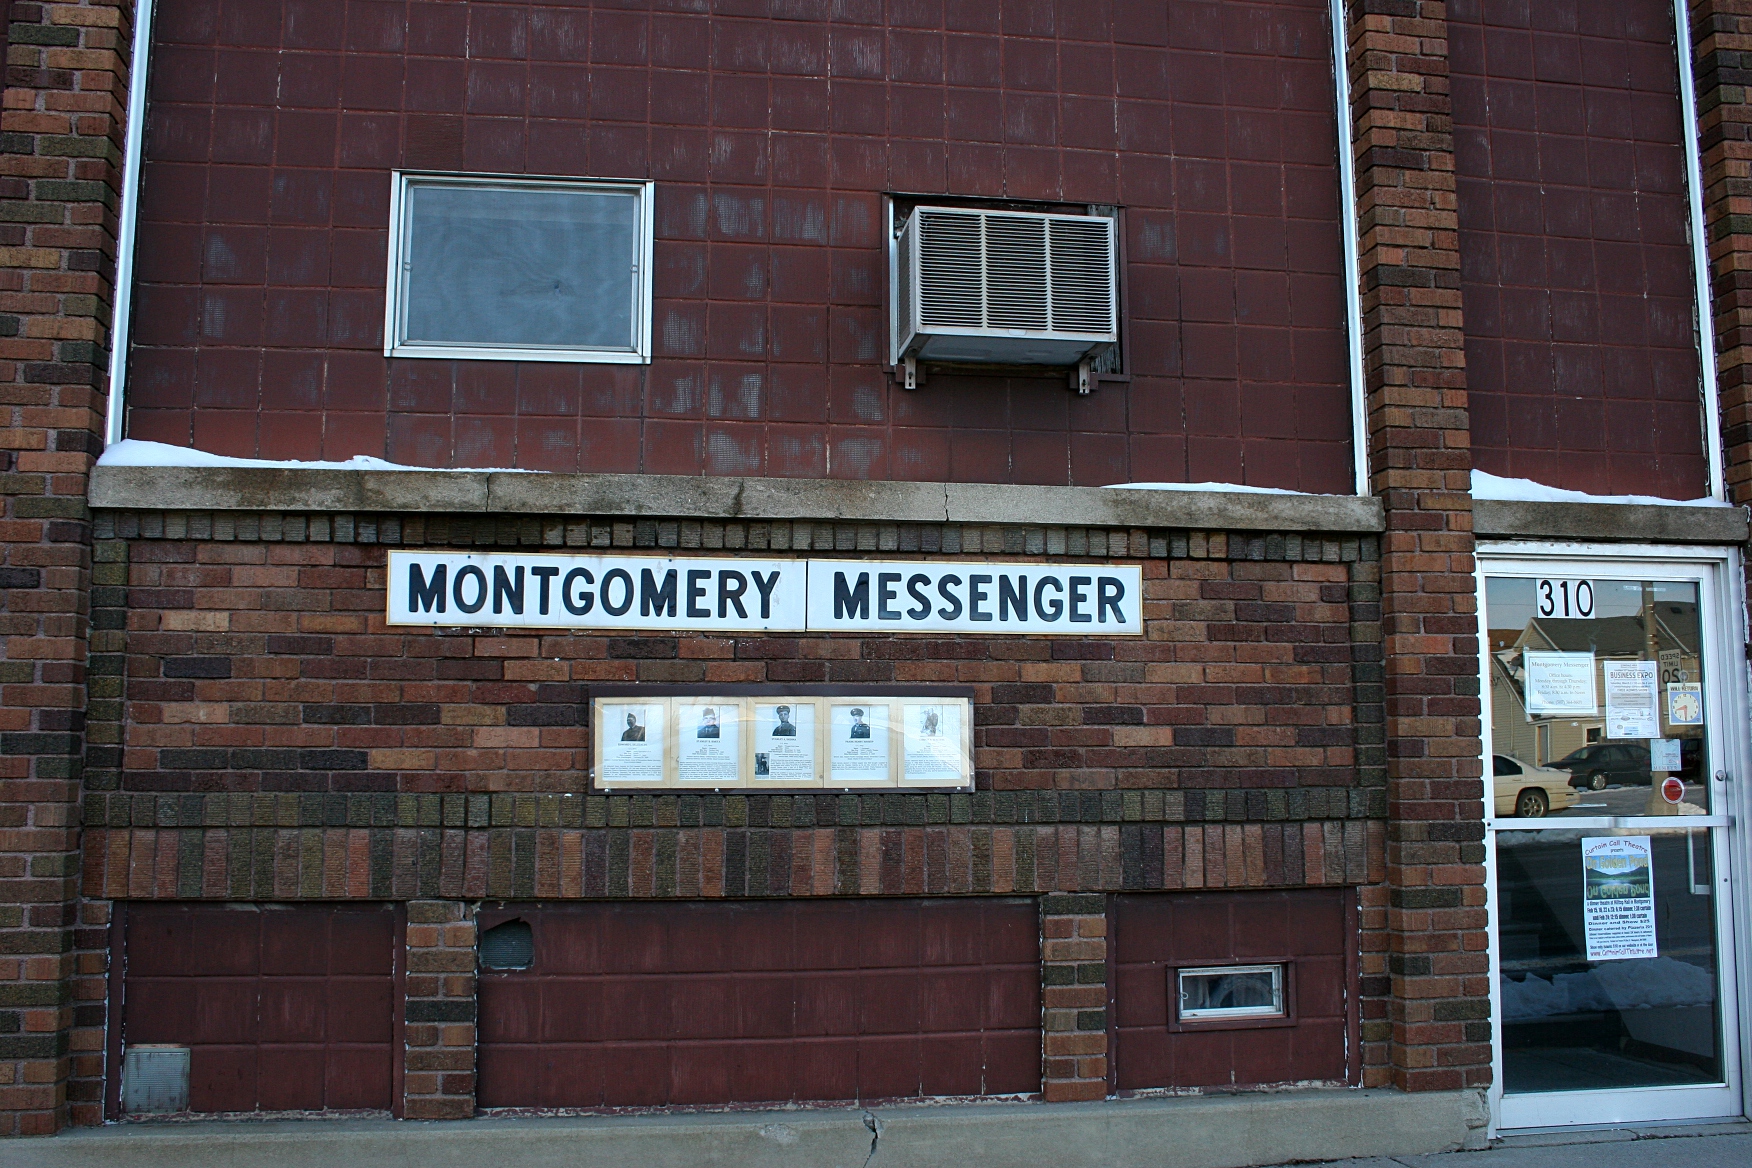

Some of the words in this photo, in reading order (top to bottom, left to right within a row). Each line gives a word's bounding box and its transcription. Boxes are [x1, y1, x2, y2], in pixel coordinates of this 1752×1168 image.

[408, 563, 781, 619] MONTGOMERY
[833, 571, 1127, 624] MESSENGER
[1539, 579, 1594, 617] 310
[1585, 842, 1608, 856] Curtain
[1624, 840, 1648, 854] Theatre
[1586, 857, 1598, 870] On
[1600, 856, 1626, 868] Golden
[1629, 854, 1648, 868] Pond
